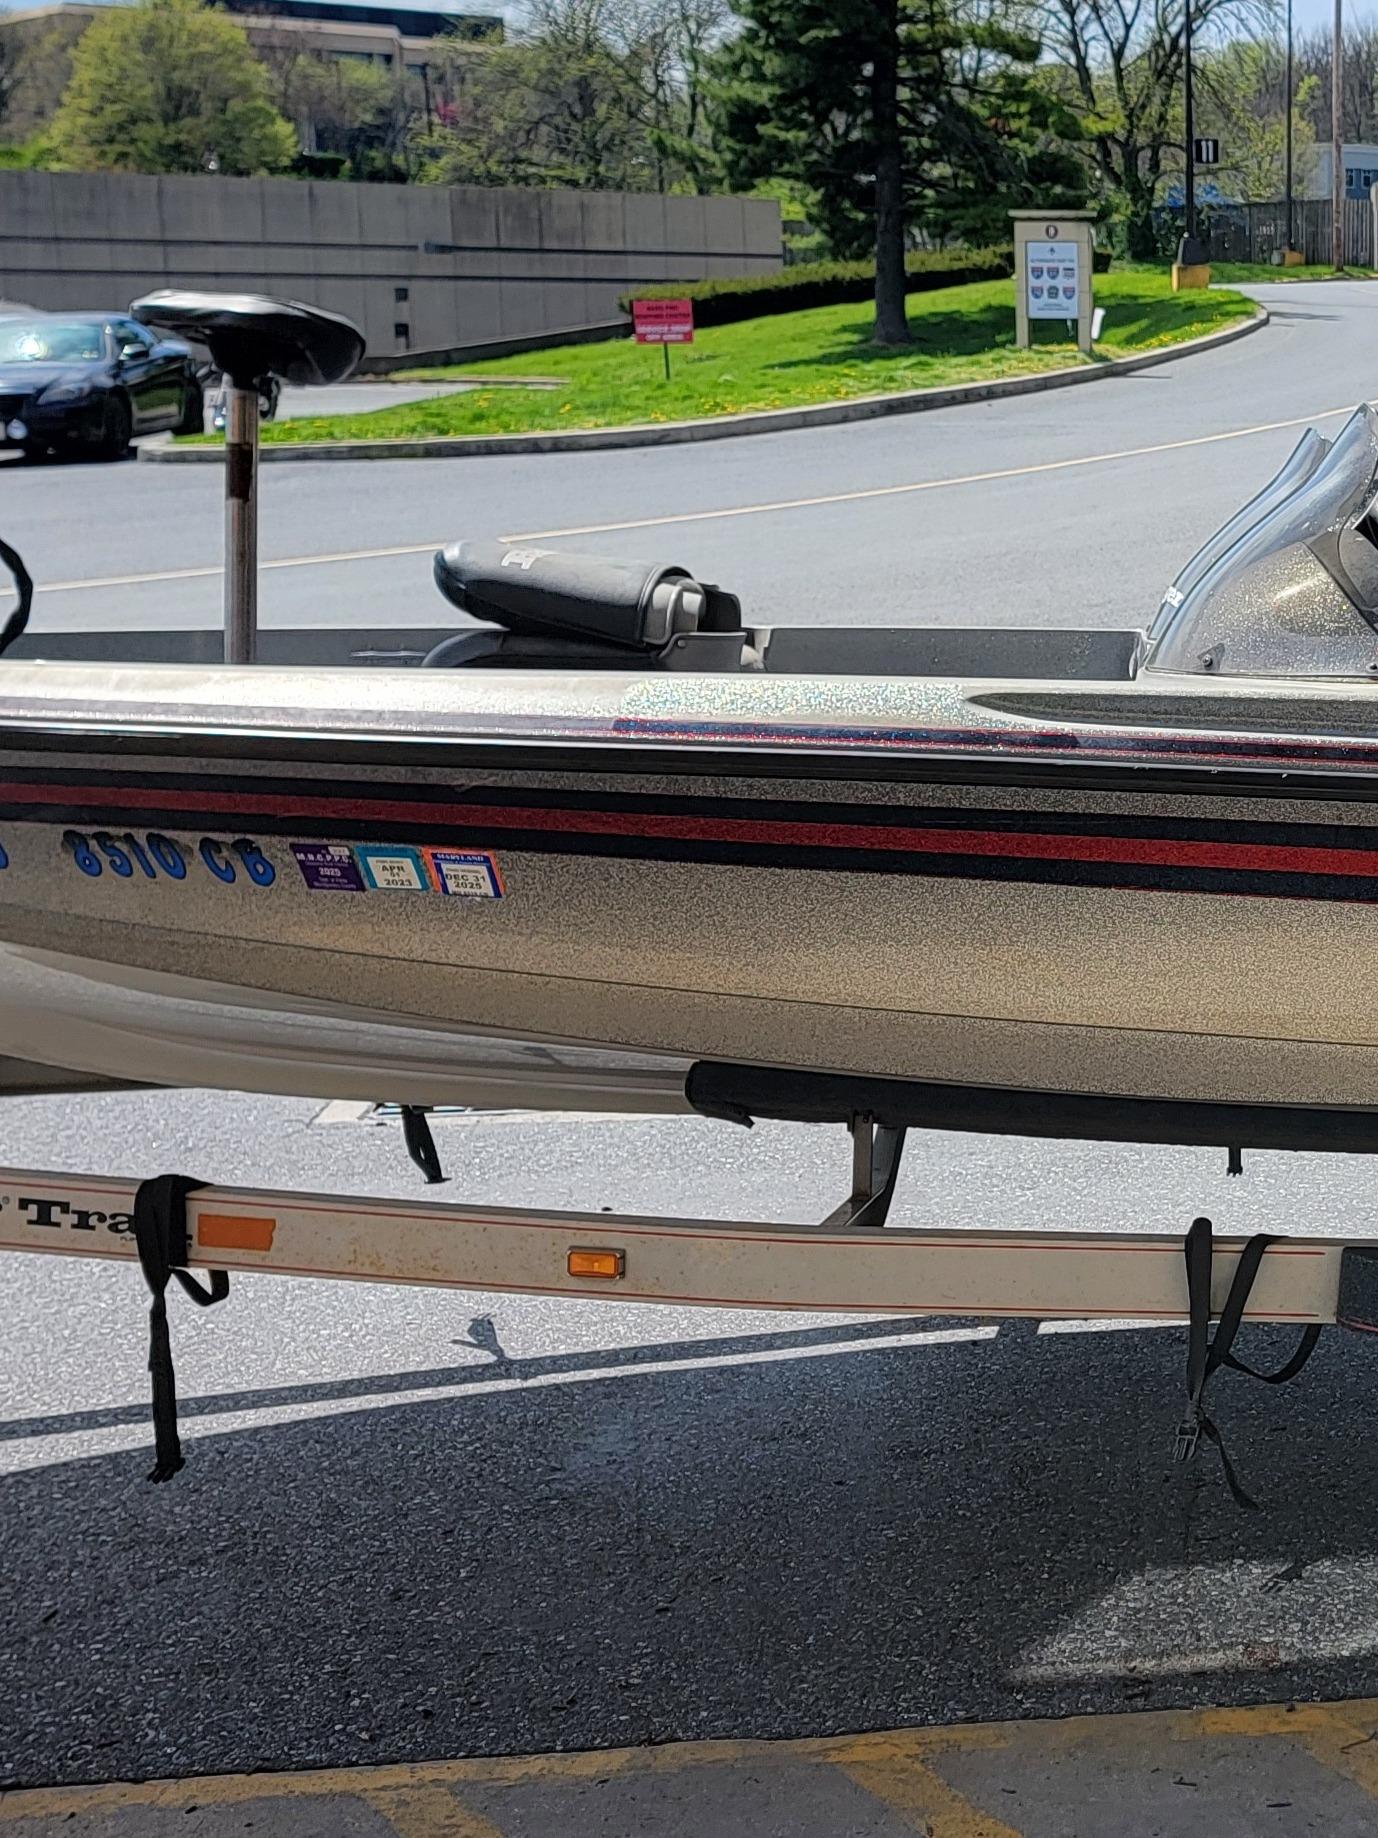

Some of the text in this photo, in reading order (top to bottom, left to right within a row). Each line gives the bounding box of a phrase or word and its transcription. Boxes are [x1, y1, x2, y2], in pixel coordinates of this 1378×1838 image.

[62, 829, 187, 880] 8510
[437, 853, 484, 862] MARYLAND
[381, 864, 406, 873] APR
[445, 873, 486, 882] DEC 31
[384, 879, 413, 887] 2023
